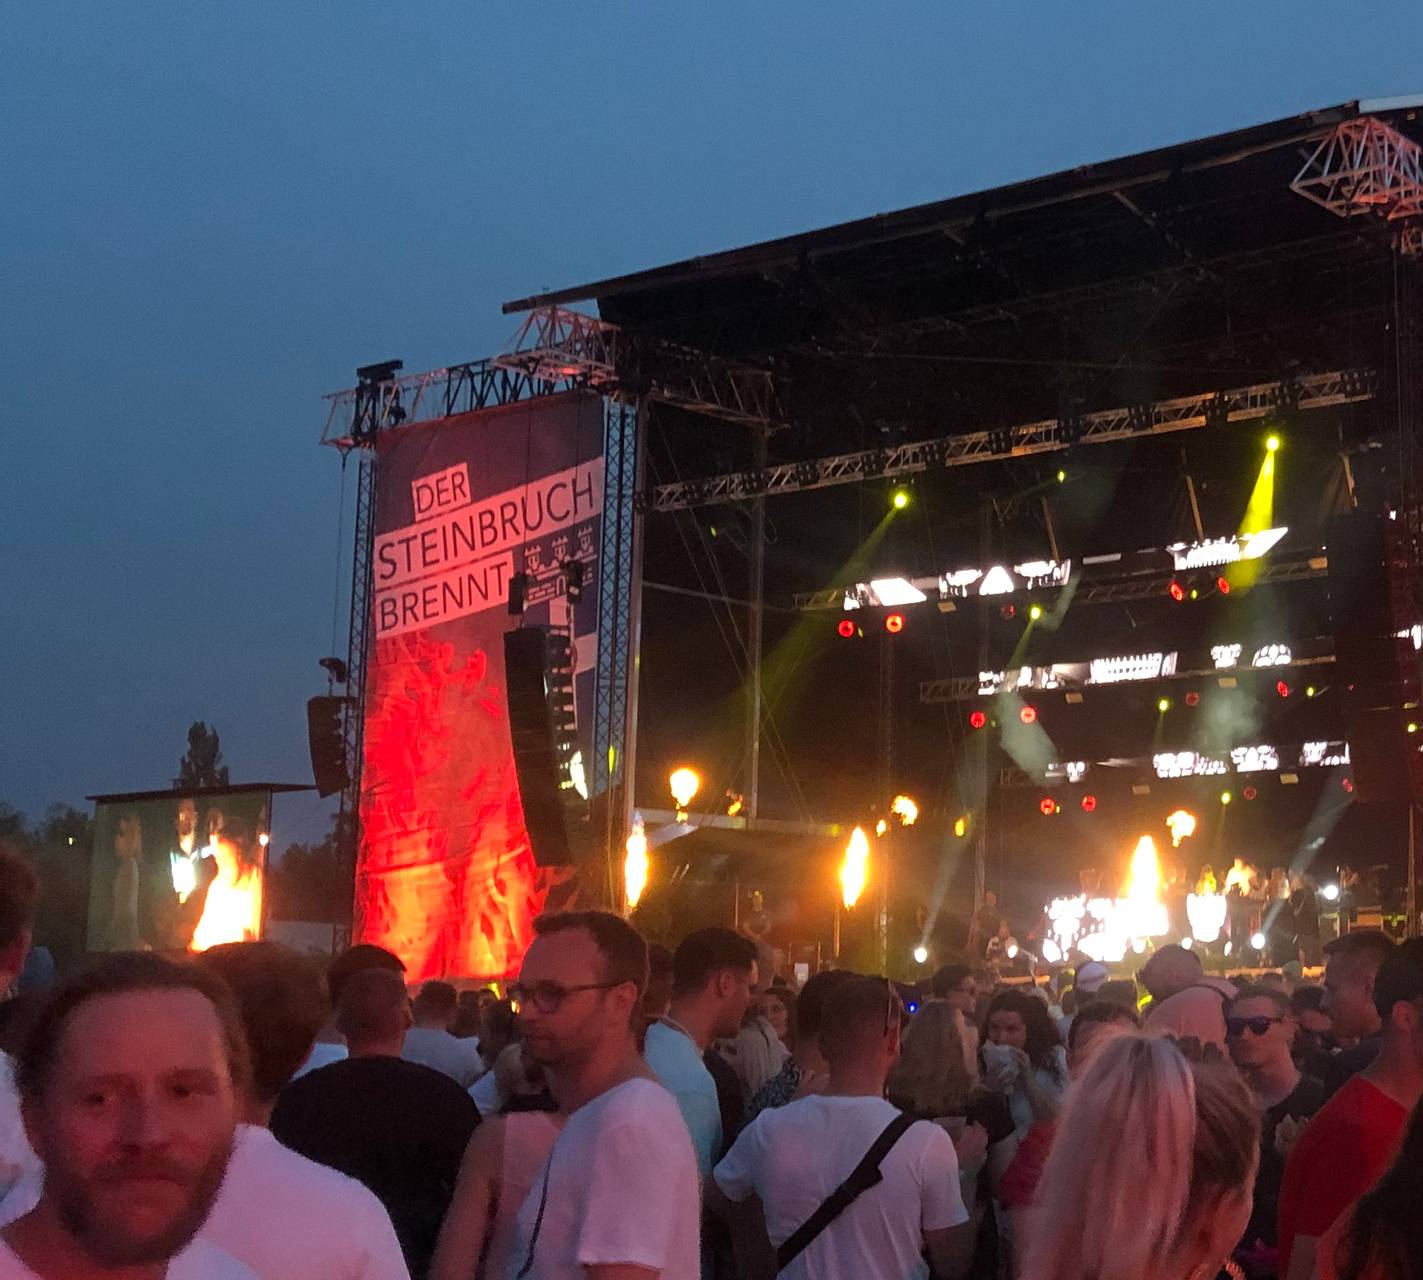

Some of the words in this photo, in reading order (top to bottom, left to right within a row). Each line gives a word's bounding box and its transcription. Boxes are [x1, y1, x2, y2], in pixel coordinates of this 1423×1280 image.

[378, 471, 594, 580] STEINBRUCH
[415, 471, 468, 514] DER
[380, 561, 508, 631] BRENNT
